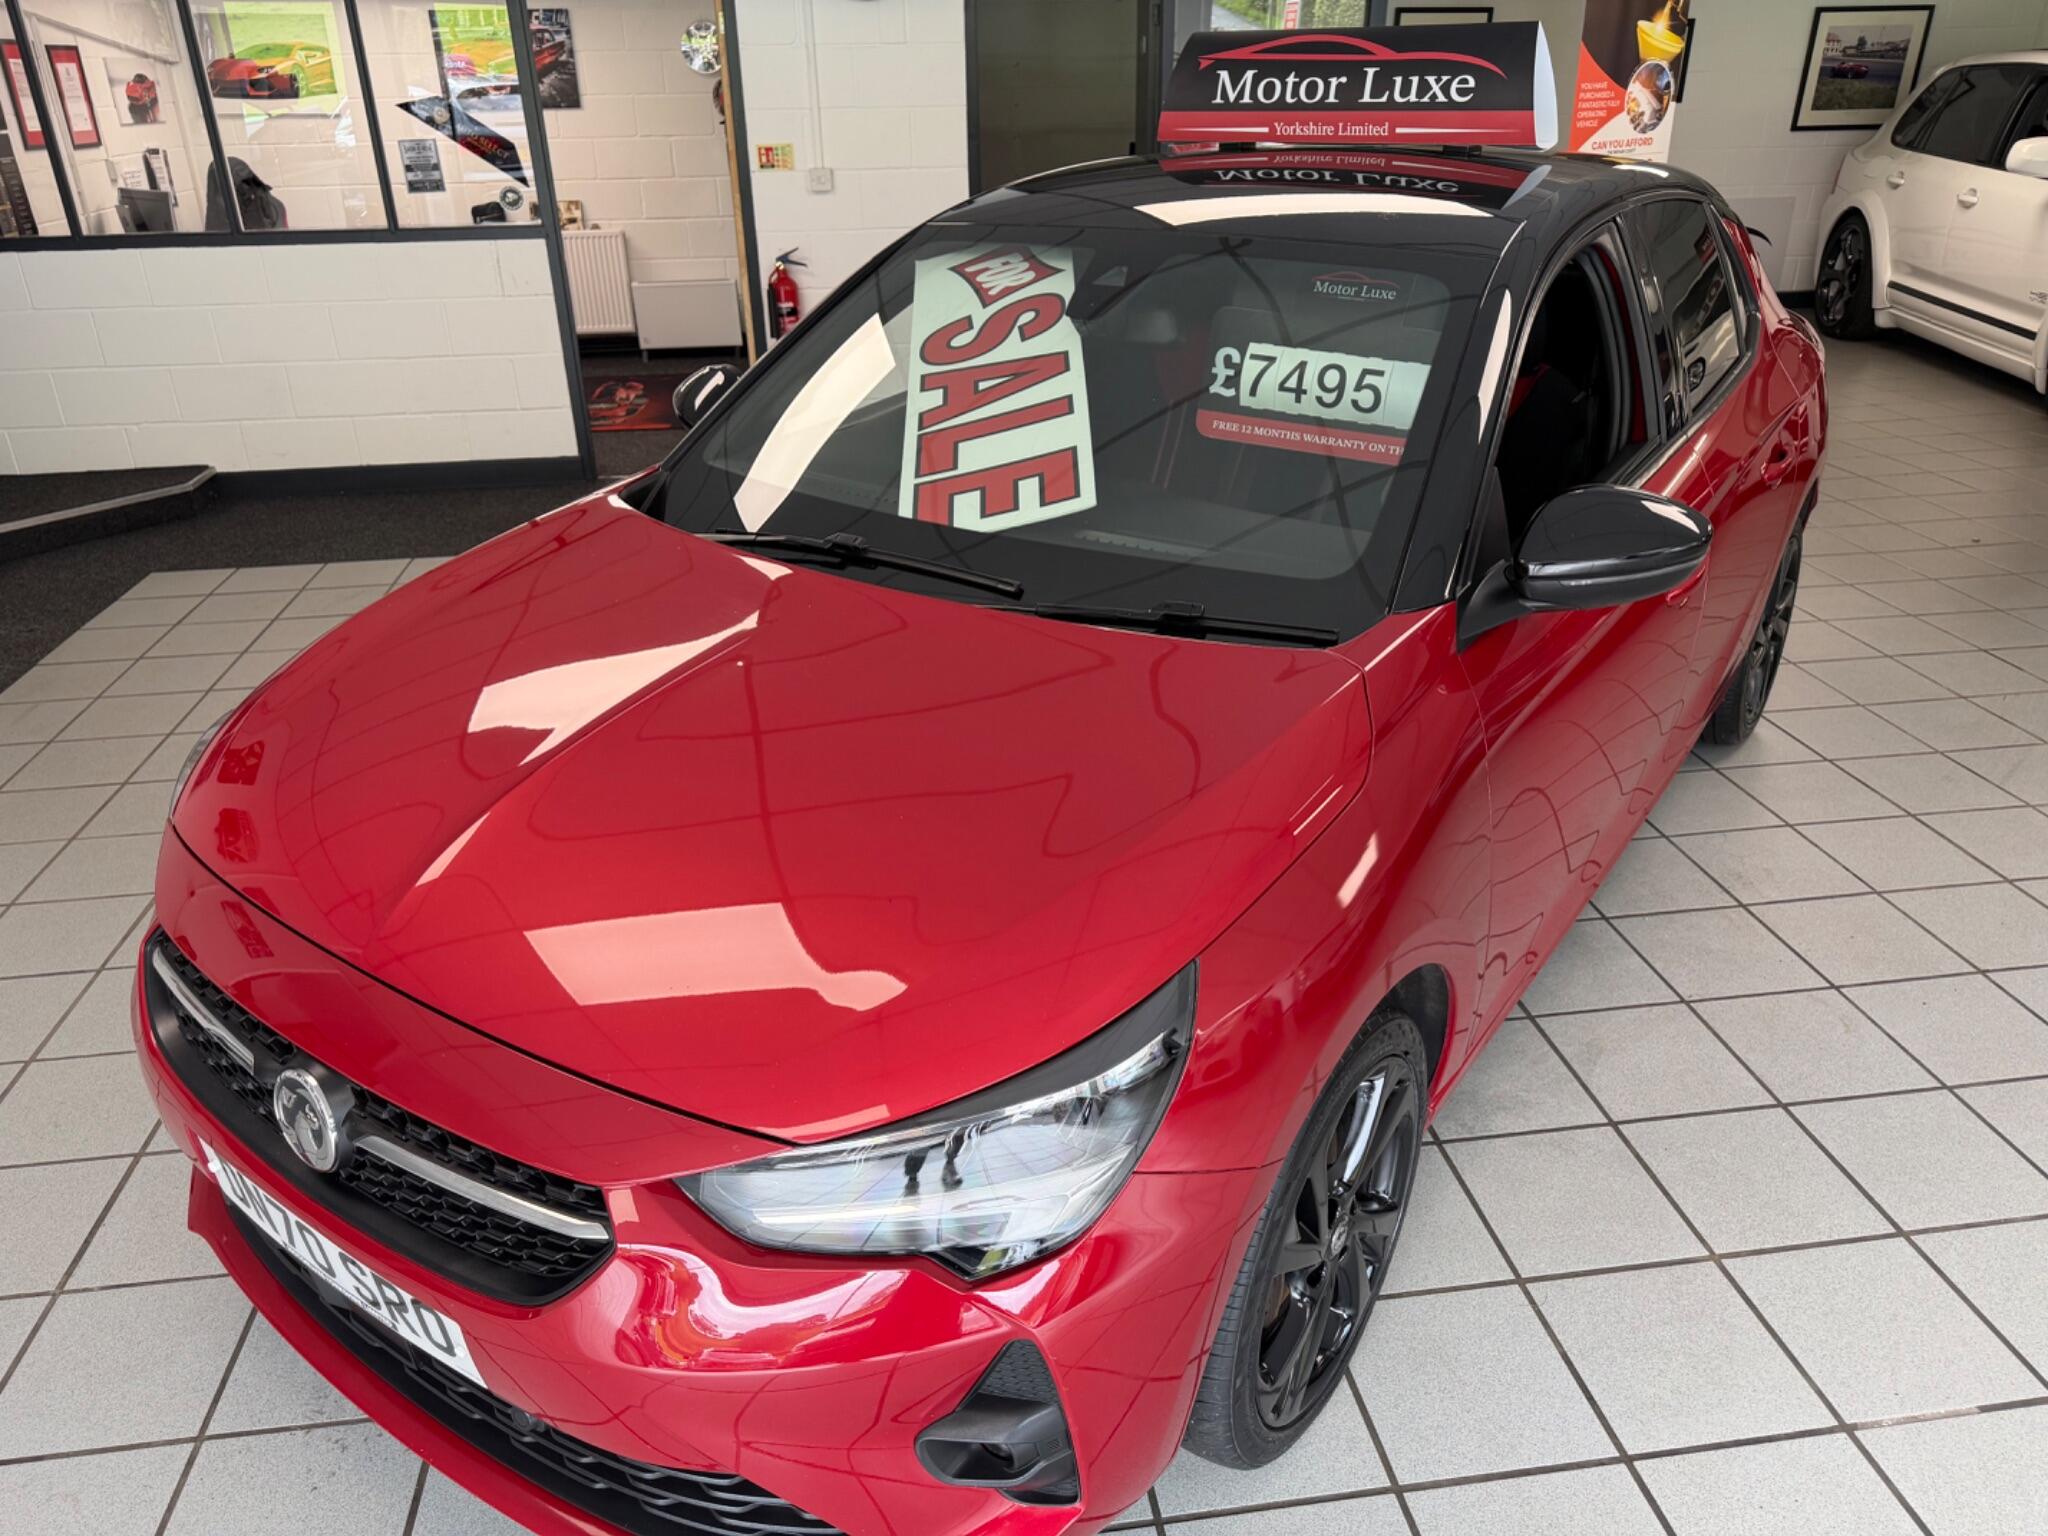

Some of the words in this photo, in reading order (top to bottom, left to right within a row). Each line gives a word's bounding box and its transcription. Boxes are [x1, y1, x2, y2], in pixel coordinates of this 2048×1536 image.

[1212, 69, 1347, 104] Motor
[1358, 67, 1475, 103] Luxe
[1274, 121, 1334, 137] Yorkshire
[1338, 121, 1389, 137] Limited
[1592, 141, 1606, 150] CAN
[1608, 139, 1624, 149] YOU
[1625, 137, 1653, 147] AFFORD
[965, 252, 1037, 296] FOR
[1313, 280, 1357, 297] Motor
[1360, 284, 1397, 300] Luxe
[1209, 346, 1385, 414] £7495
[914, 291, 1081, 528] SALE
[1212, 420, 1240, 432] FREE
[1241, 425, 1252, 434] 12
[1253, 426, 1301, 441] MONTHS
[1303, 432, 1367, 450] WARRANTY
[1368, 442, 1387, 453] ON
[338, 1251, 456, 1358] SRO
